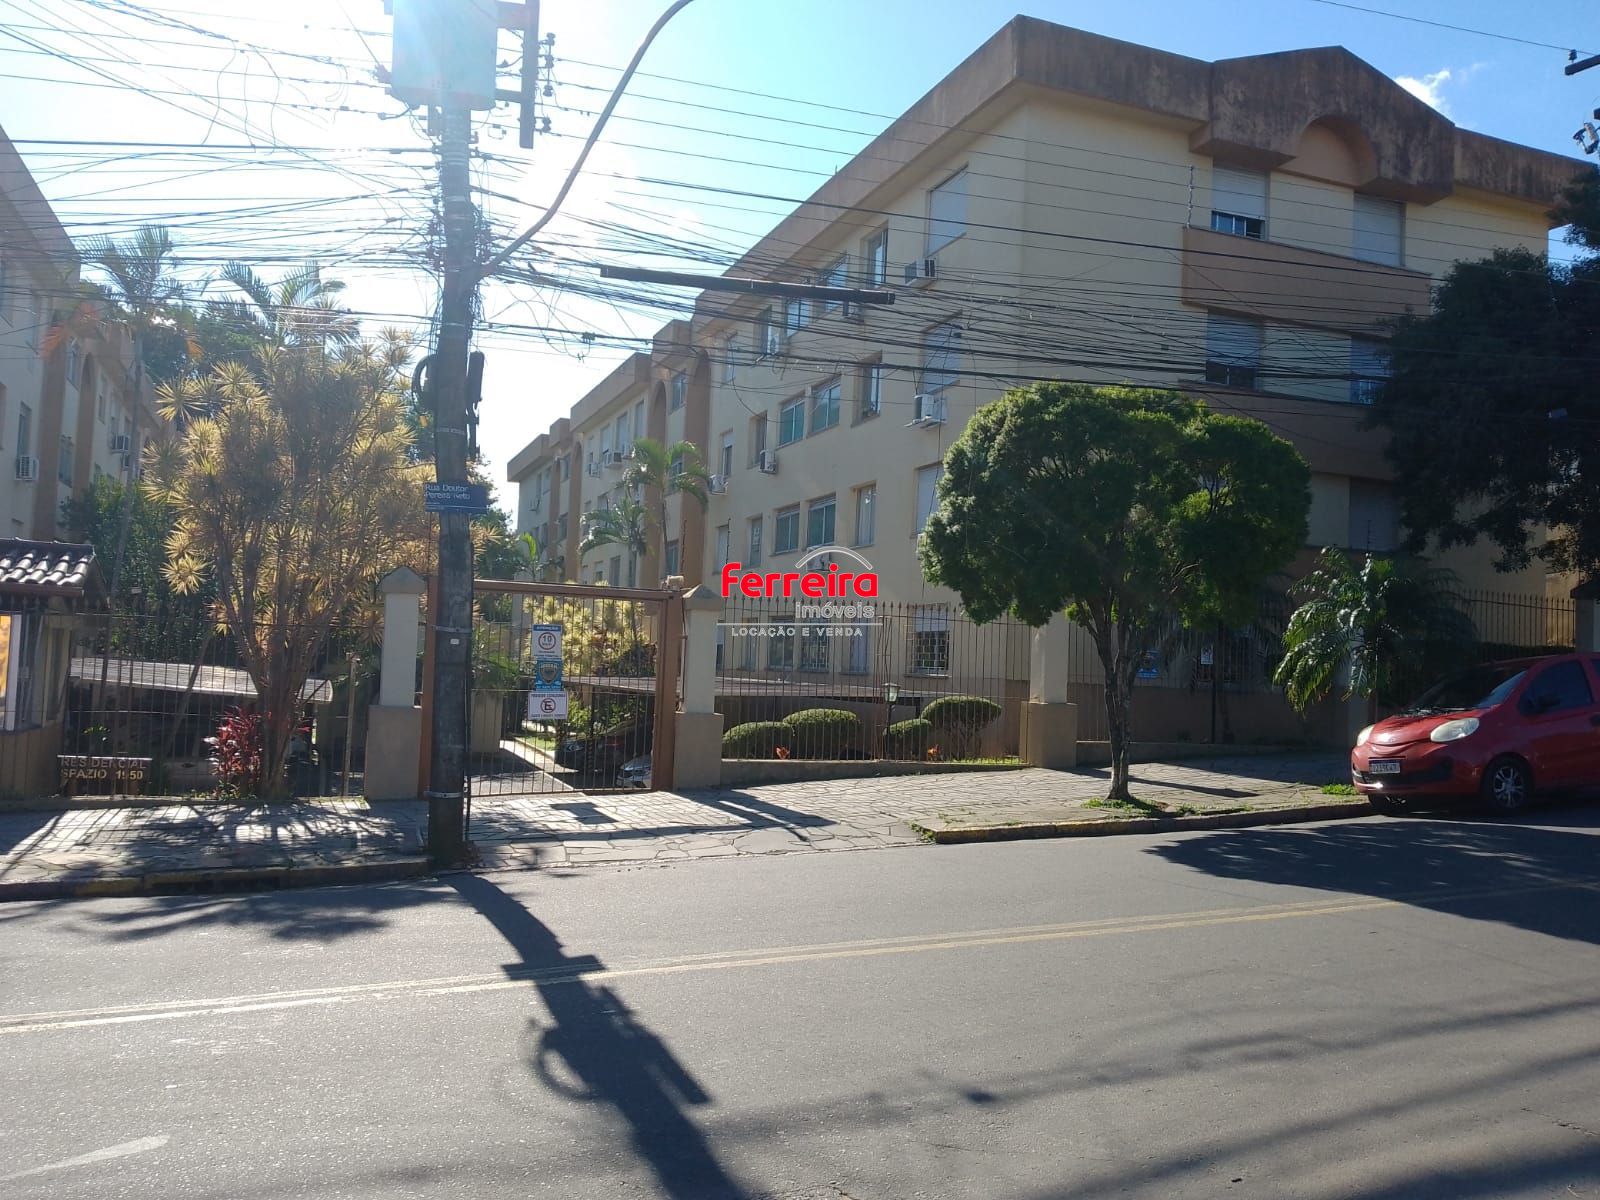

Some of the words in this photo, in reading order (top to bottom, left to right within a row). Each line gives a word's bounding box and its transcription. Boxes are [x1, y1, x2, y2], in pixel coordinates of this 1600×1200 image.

[425, 483, 440, 491] Rua
[542, 634, 552, 643] 10
[60, 768, 107, 779] SPAZIO
